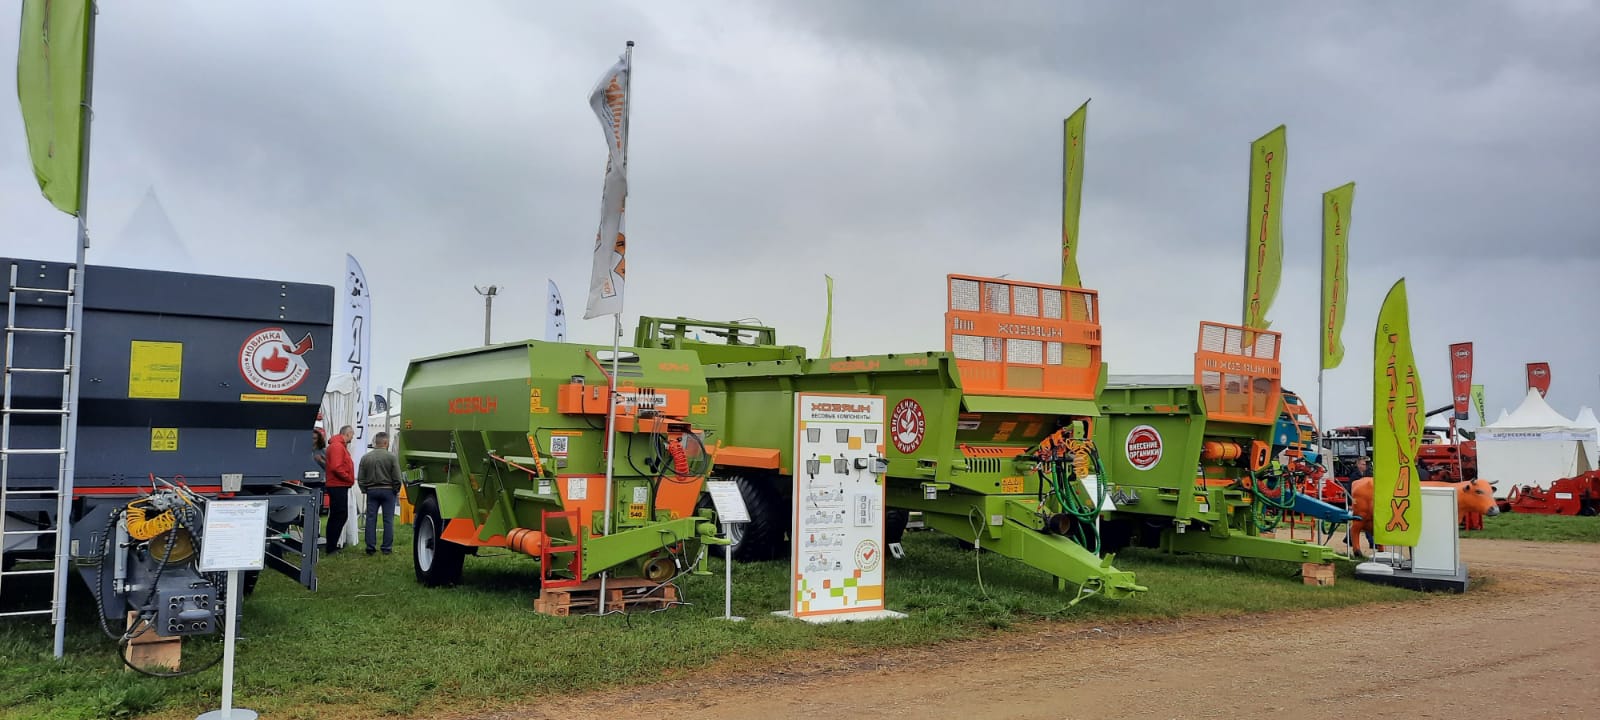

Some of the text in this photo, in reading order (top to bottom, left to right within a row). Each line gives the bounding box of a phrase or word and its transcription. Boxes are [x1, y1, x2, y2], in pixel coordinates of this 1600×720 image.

[244, 332, 281, 358] НОВИНКА
[448, 396, 498, 414] ХОЗЯИН
[811, 402, 871, 413] ХОЗЯИН
[891, 400, 918, 433] ВНЕСЕНИЕ
[897, 420, 925, 453] ОРГАНИКИ
[1129, 441, 1158, 451] ВНЕСЕНИЕ
[1129, 449, 1160, 459] ОРГАНИКИ
